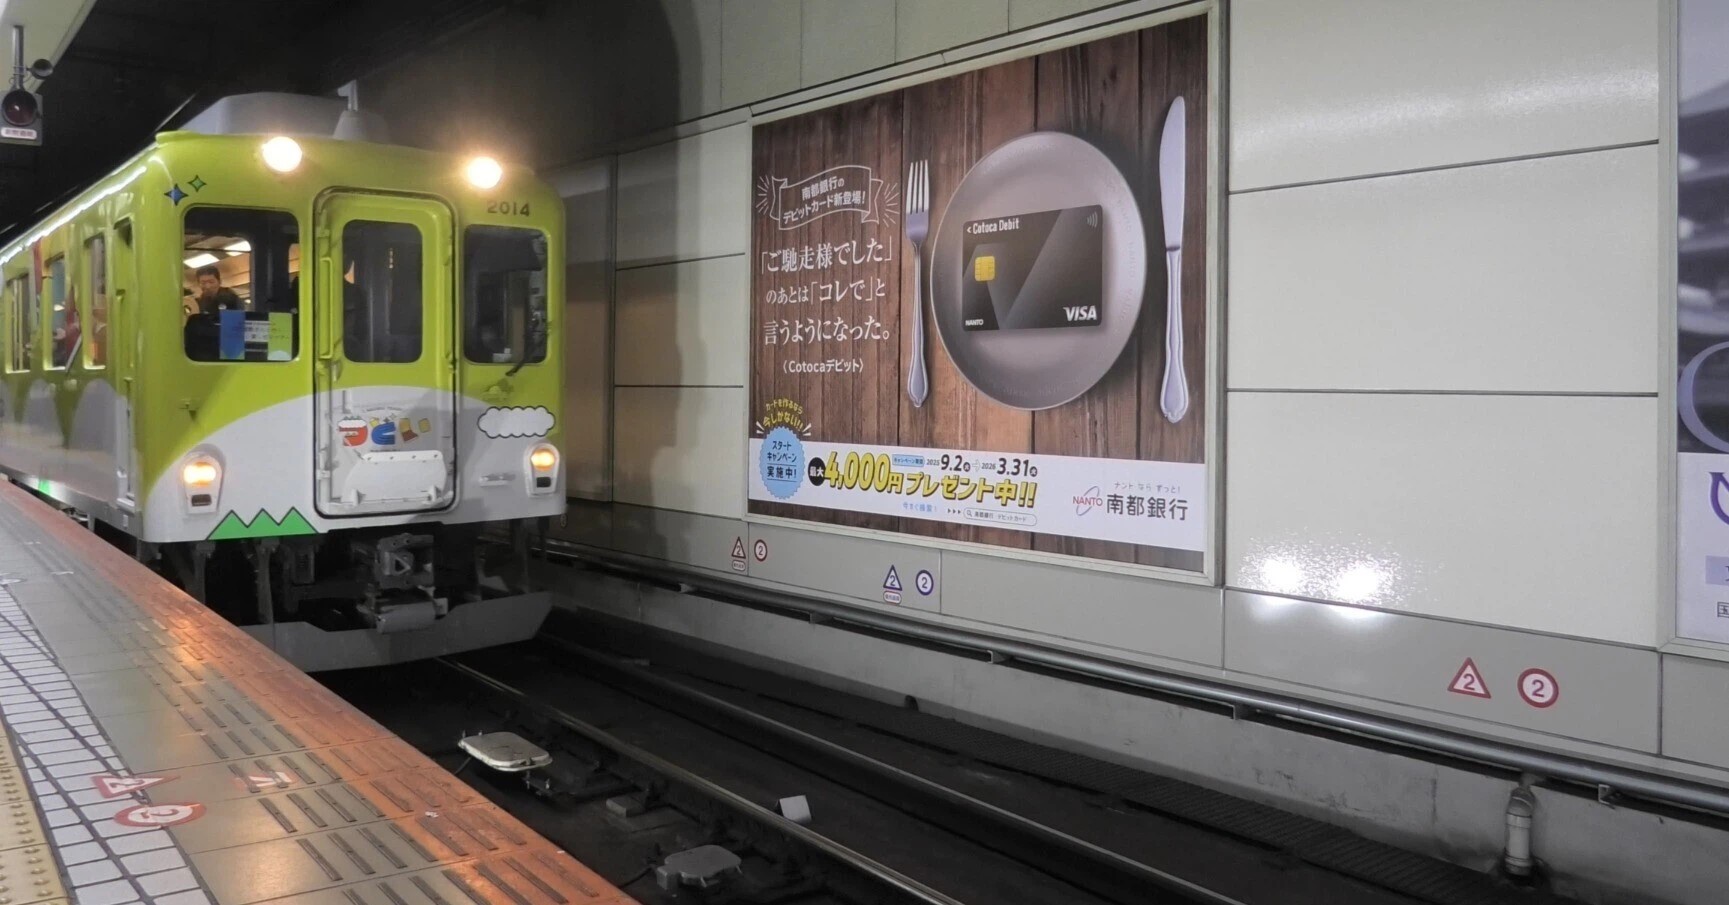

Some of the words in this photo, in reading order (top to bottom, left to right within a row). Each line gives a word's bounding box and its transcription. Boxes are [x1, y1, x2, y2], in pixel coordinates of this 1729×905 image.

[801, 176, 845, 201] 南都銀行の
[487, 200, 530, 217] 2014
[782, 190, 866, 225] デビットカード新登場!
[972, 222, 998, 235] Cotoca
[998, 217, 1020, 231] Debit
[761, 235, 892, 275] 「ご馳走様でした」
[765, 276, 886, 305] のあとは「コレで」と
[965, 318, 984, 326] NANTO
[1063, 305, 1097, 321] VISA
[763, 315, 890, 345] 言うようになった。
[772, 440, 792, 451] スタート
[767, 451, 797, 463] キャンペーン
[1072, 495, 1103, 507] NANTO
[1106, 493, 1189, 521] 南都銀行
[889, 574, 896, 587] 2
[921, 576, 928, 589] 2
[1463, 673, 1475, 691] 2
[1531, 679, 1544, 698] 2
